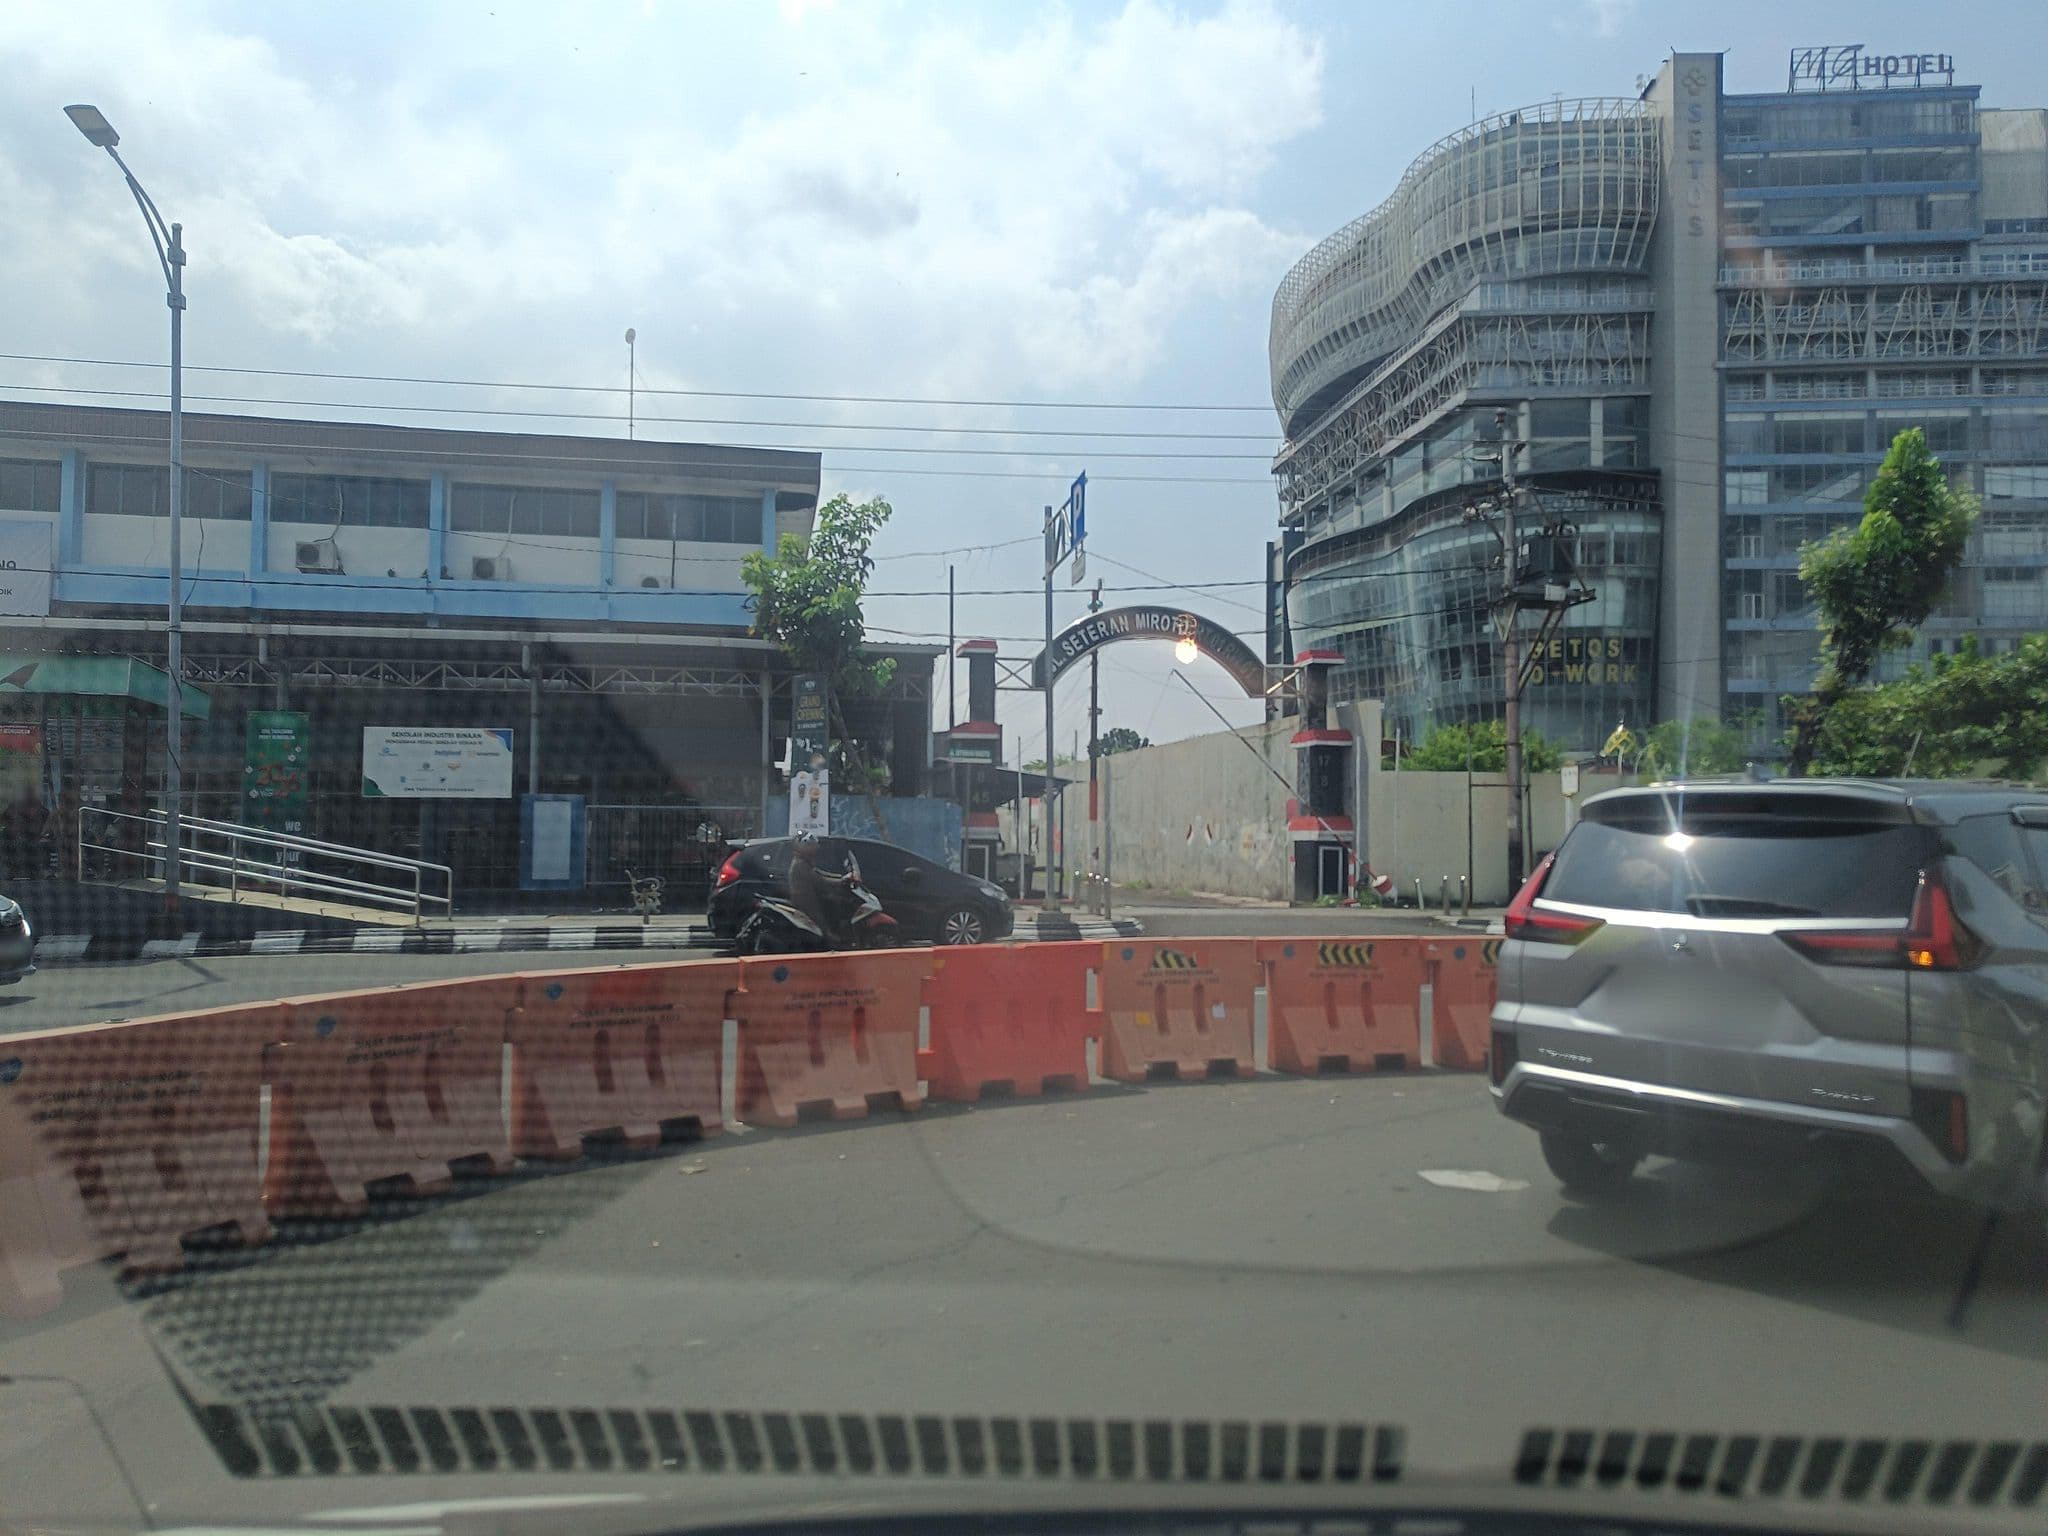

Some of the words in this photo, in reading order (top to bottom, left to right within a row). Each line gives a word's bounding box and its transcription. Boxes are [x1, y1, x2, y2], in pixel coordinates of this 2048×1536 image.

[1864, 53, 1955, 77] HOTEL
[1073, 483, 1082, 537] P
[1061, 615, 1130, 656] SETERAN
